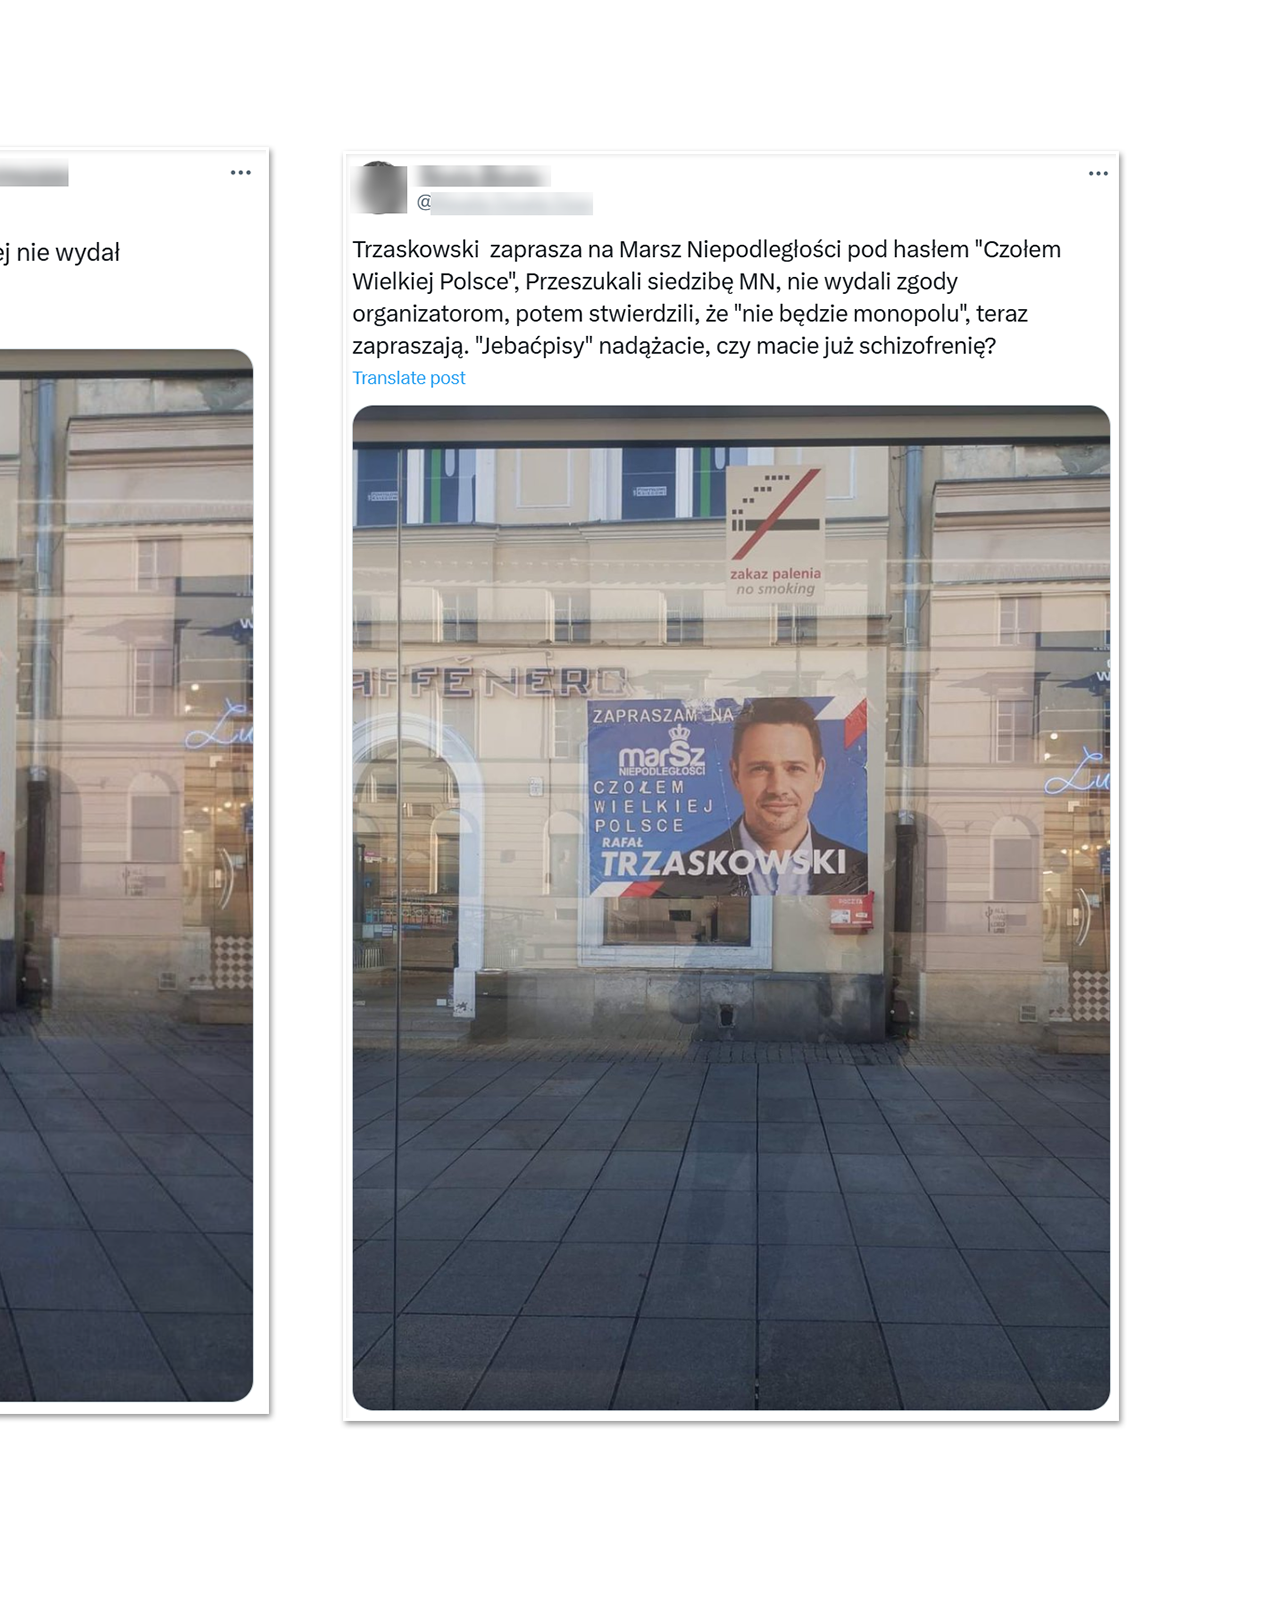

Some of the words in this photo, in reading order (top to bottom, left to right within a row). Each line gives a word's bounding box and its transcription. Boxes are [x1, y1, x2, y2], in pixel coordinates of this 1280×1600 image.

[730, 568, 768, 579] zakaz
[772, 567, 822, 582] palenia
[736, 585, 754, 595] no
[758, 582, 816, 597] smoking
[593, 708, 698, 724] ZAPRASZAM
[711, 707, 734, 722] NA
[593, 780, 684, 795] CZOŁEM
[594, 798, 713, 814] WIELKIEJ
[594, 818, 684, 833] POLSCE
[602, 837, 644, 848] RAFAŁ
[601, 849, 847, 876] TRZASKOWSKI
